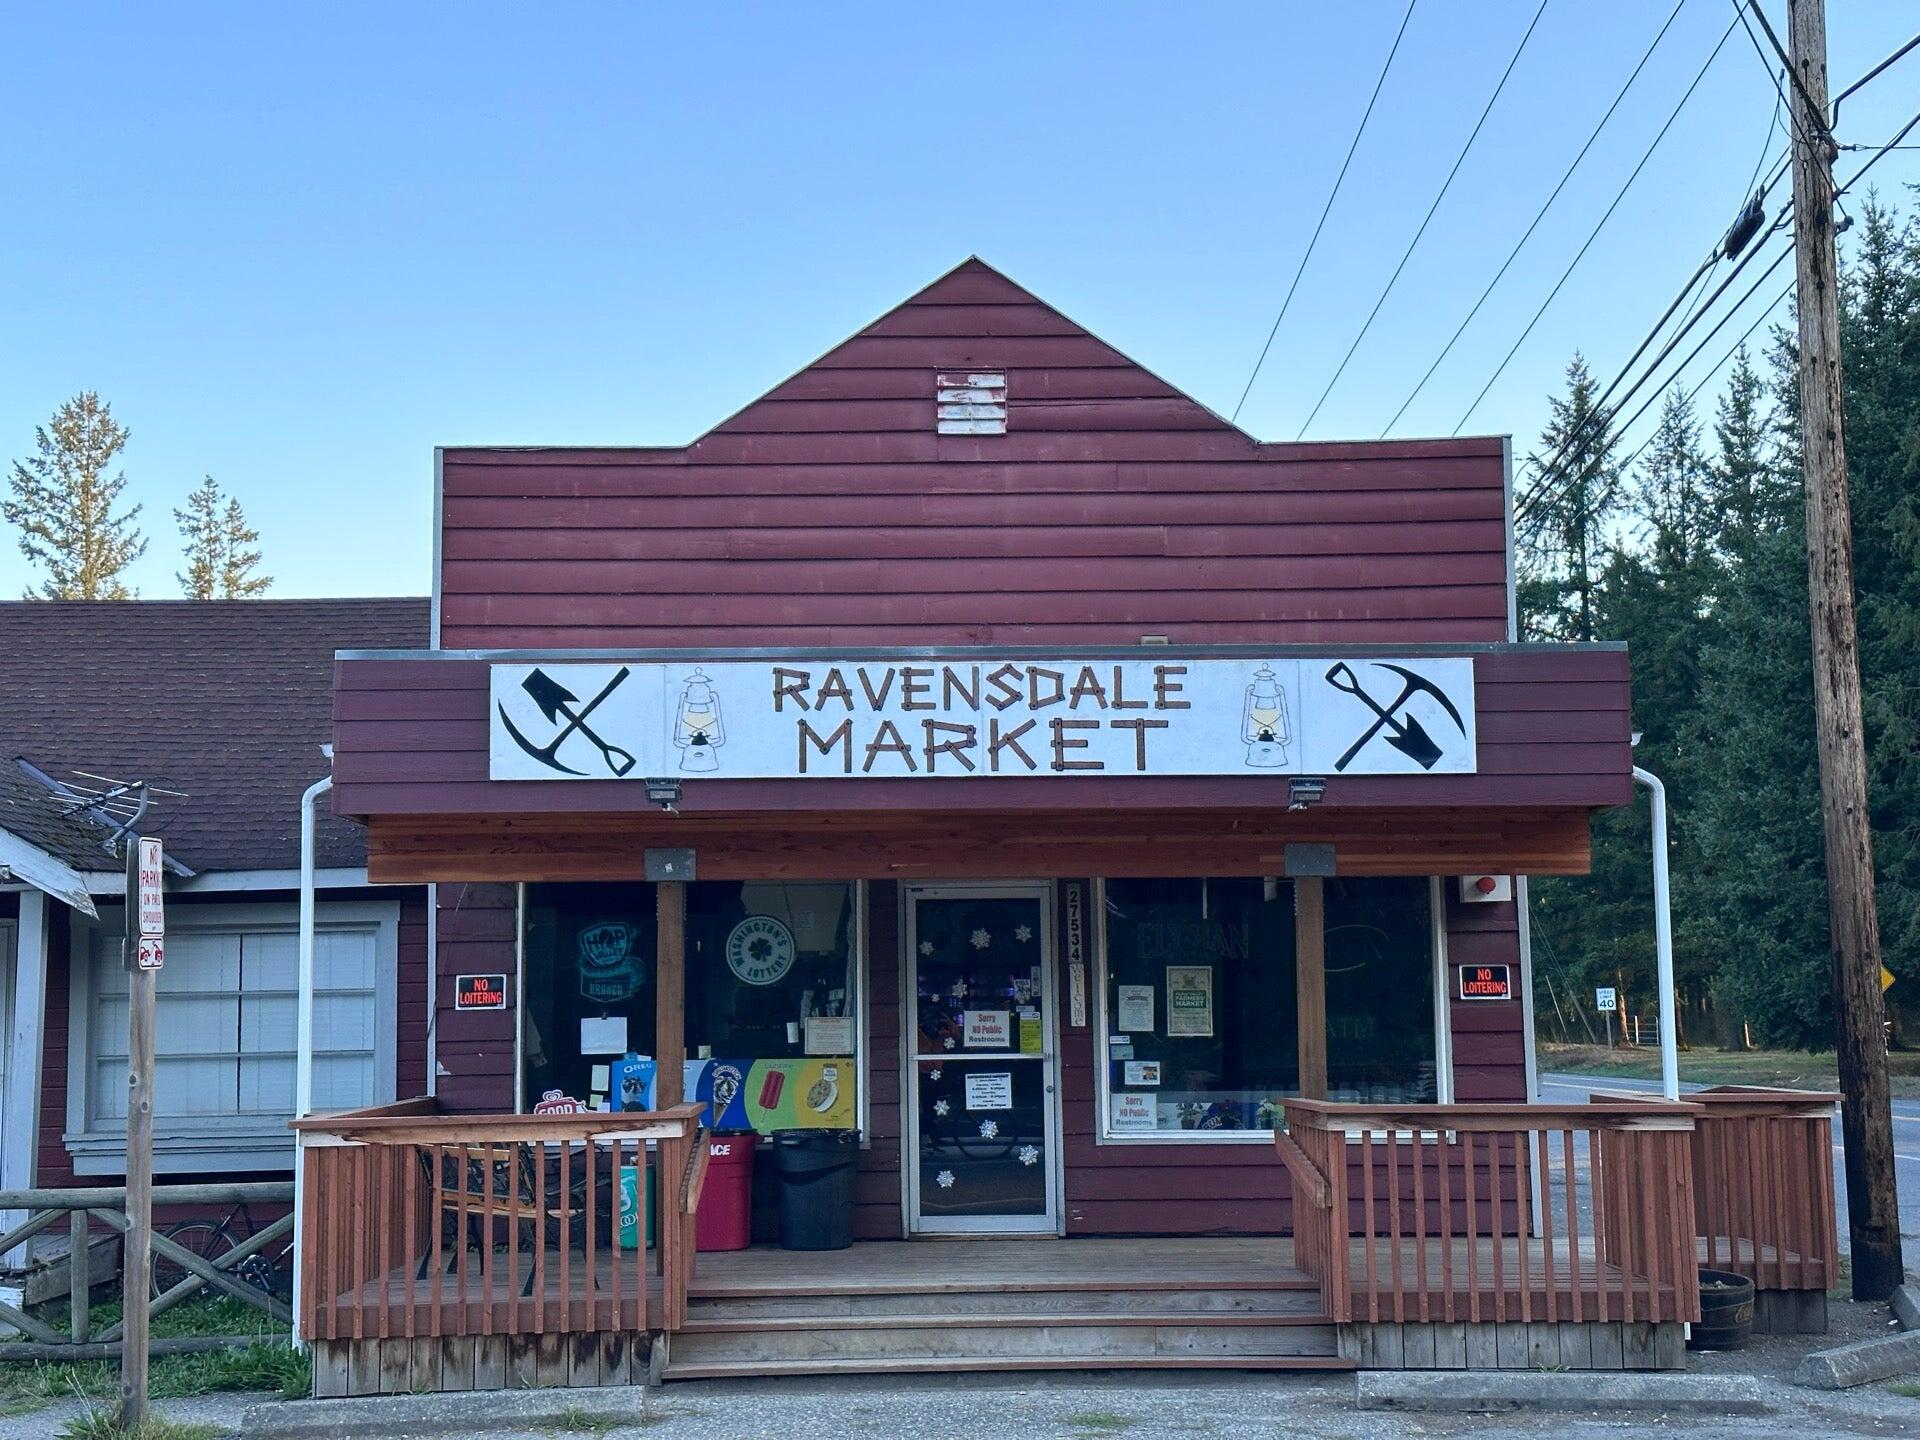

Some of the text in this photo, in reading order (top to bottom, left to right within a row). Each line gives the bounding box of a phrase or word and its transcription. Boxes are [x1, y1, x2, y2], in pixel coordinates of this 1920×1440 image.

[772, 664, 1190, 712] RAVENSDALE
[797, 718, 1169, 773] MARKET
[149, 847, 158, 865] NO
[1069, 891, 1080, 960] 27534
[732, 922, 788, 967] WASHINGTON'S
[747, 954, 787, 979] LOTTERY
[1477, 968, 1492, 980] NO
[474, 978, 488, 991] NO
[1463, 981, 1507, 994] LOITERING
[459, 991, 502, 1004] LOITERING
[1599, 999, 1614, 1008] 40
[978, 1013, 996, 1023] Sorry
[982, 1025, 1002, 1034] Public
[1125, 1096, 1143, 1106] Sorry
[1116, 1118, 1152, 1126] Restrooms
